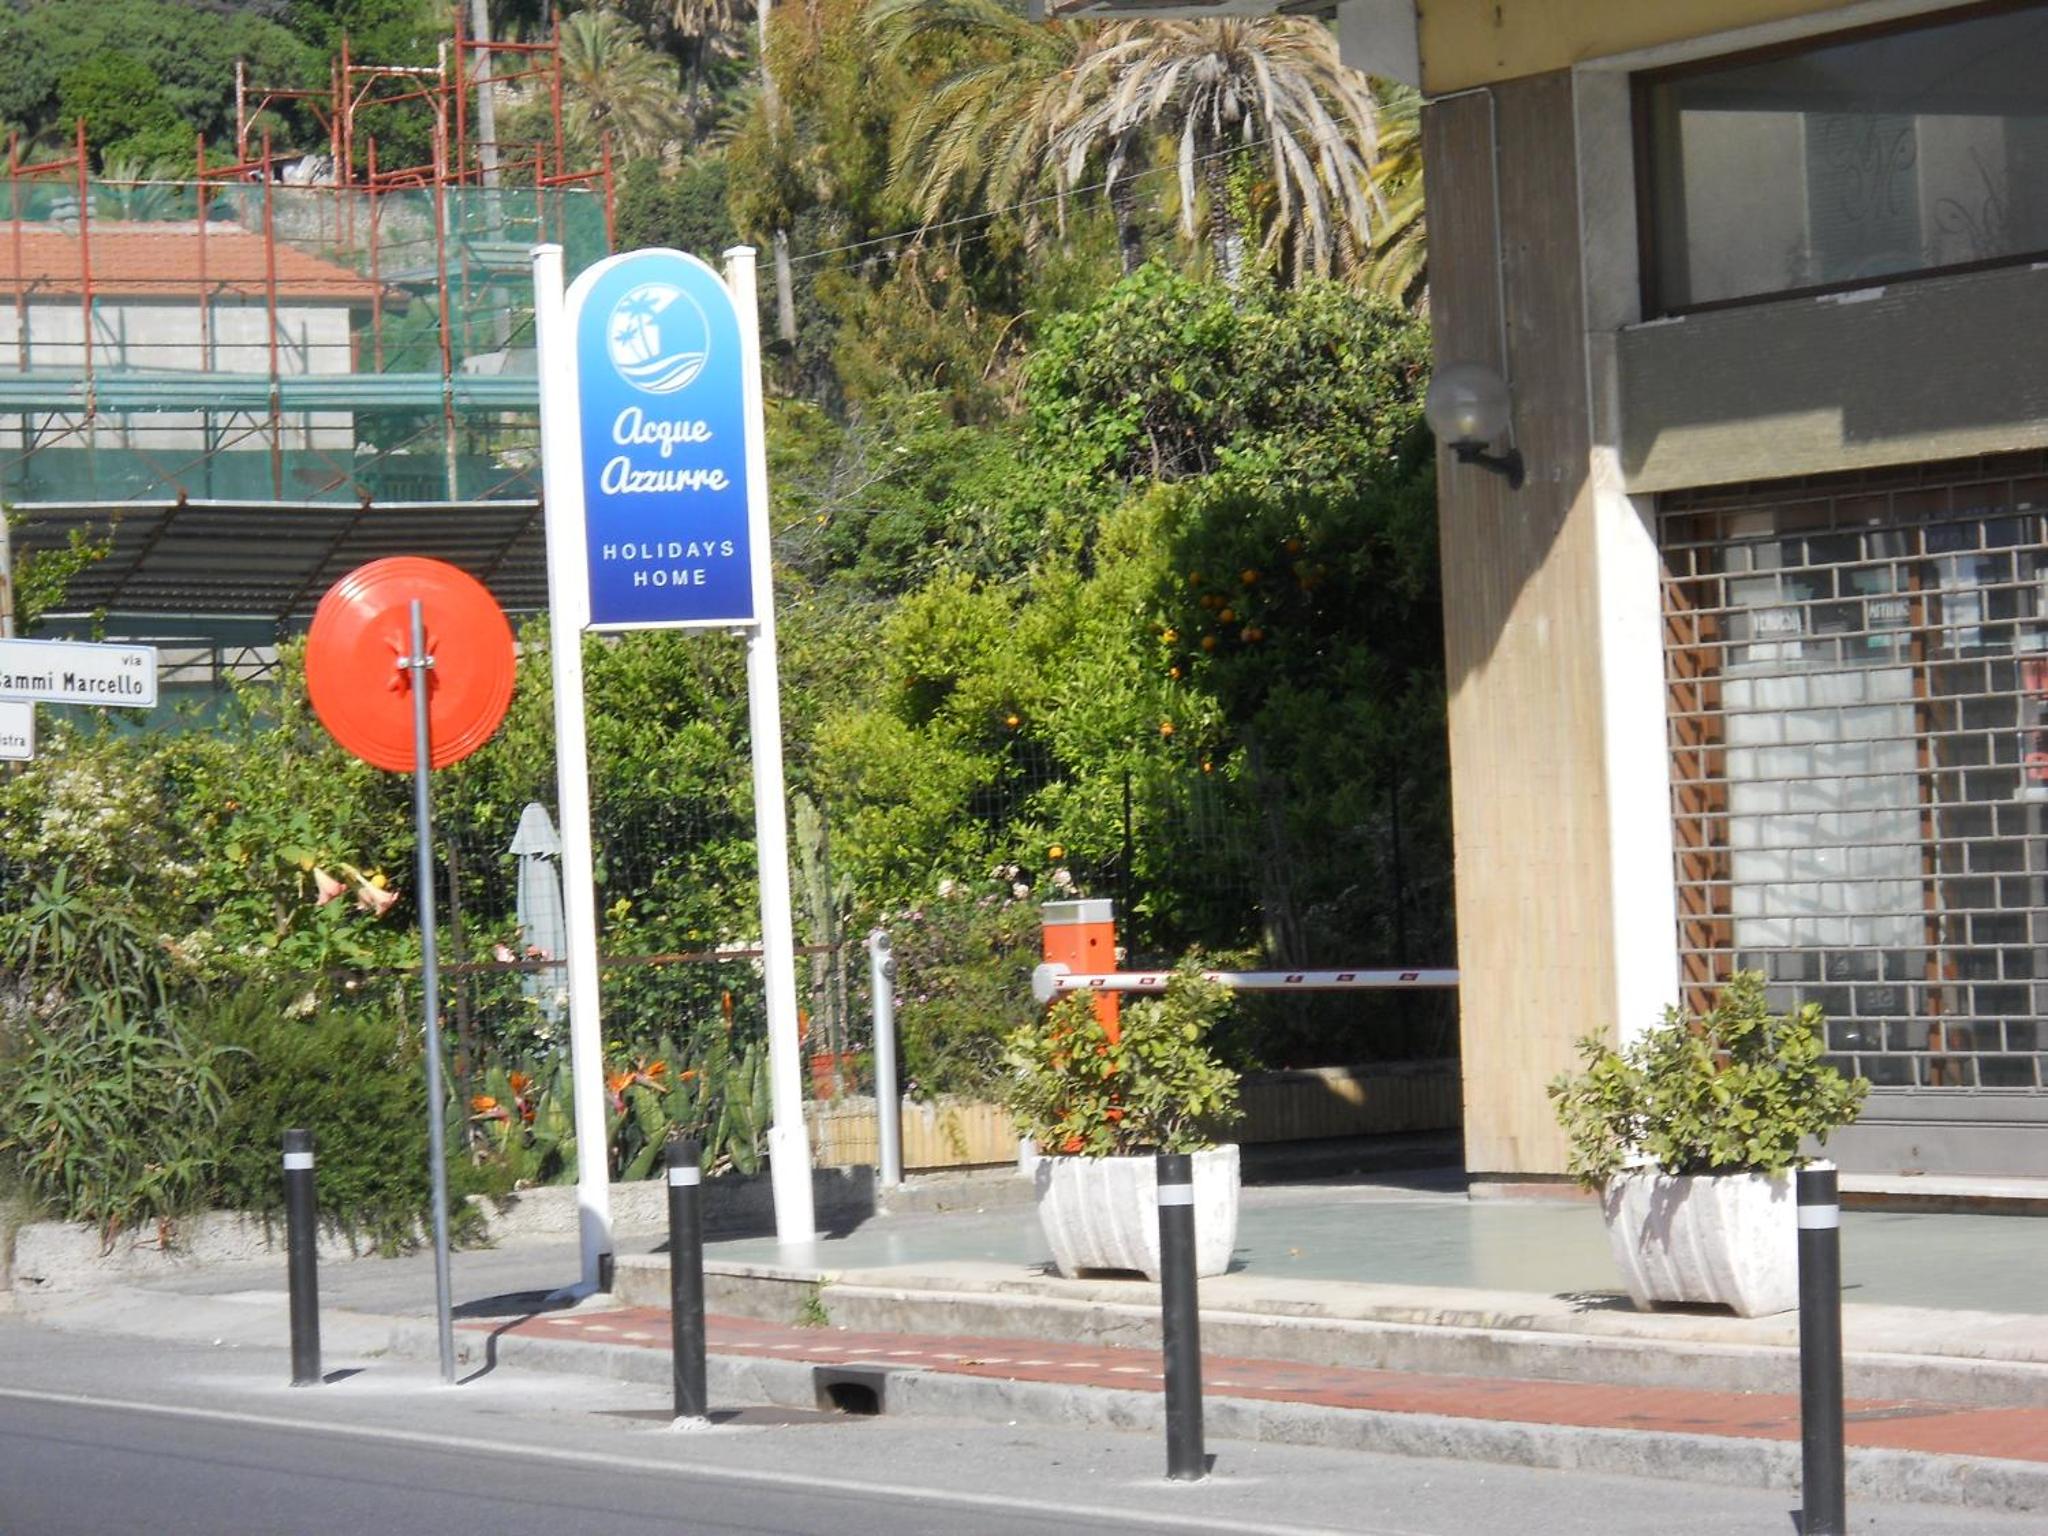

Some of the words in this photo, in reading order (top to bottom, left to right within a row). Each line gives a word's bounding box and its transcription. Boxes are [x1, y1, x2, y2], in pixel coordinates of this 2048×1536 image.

[613, 406, 712, 457] Acque
[601, 456, 730, 494] Azzurre
[603, 541, 734, 560] HOLIDAYS
[633, 569, 706, 587] HOME
[122, 656, 142, 666] via
[63, 673, 143, 694] Marcello
